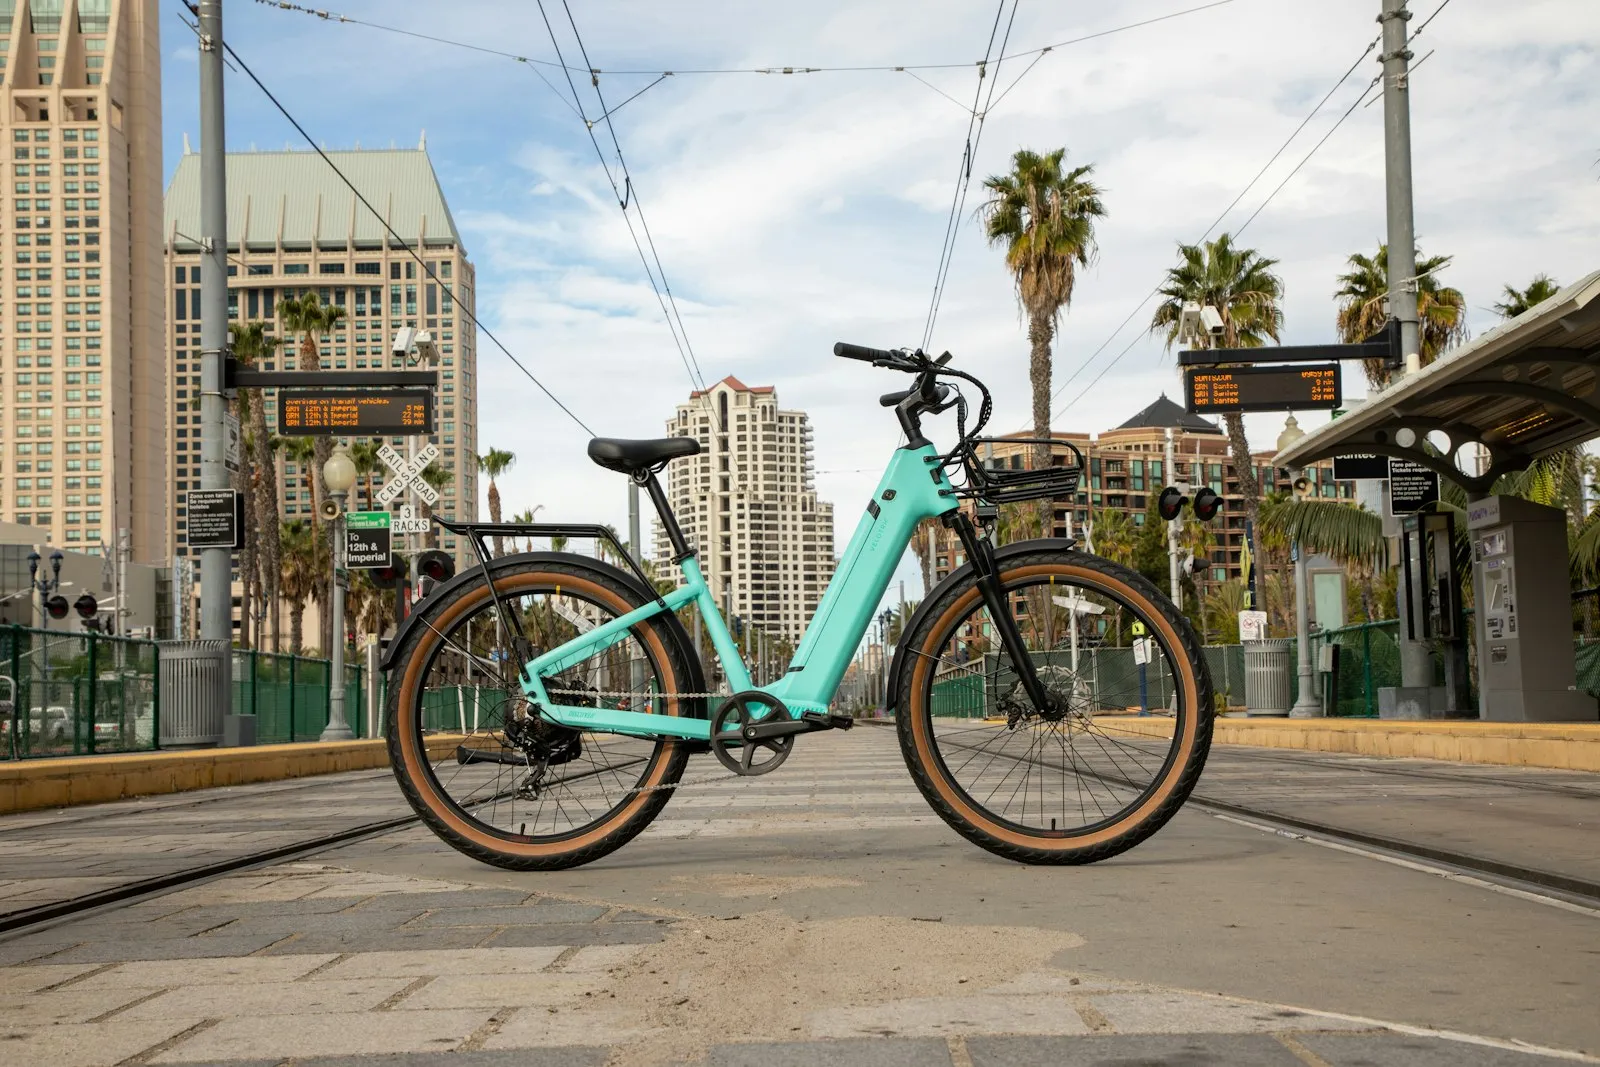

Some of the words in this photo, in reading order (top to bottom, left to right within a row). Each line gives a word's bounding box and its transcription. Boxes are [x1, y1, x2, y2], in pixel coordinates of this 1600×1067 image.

[285, 411, 299, 419] GRN
[305, 411, 321, 419] 12th
[330, 411, 358, 419] Imperial
[330, 418, 358, 427] Imperial
[404, 507, 411, 518] 3
[391, 520, 428, 531] RACKS
[348, 532, 359, 541] To
[348, 543, 368, 552] 12th
[370, 542, 378, 551] &
[348, 552, 386, 563] Imperial
